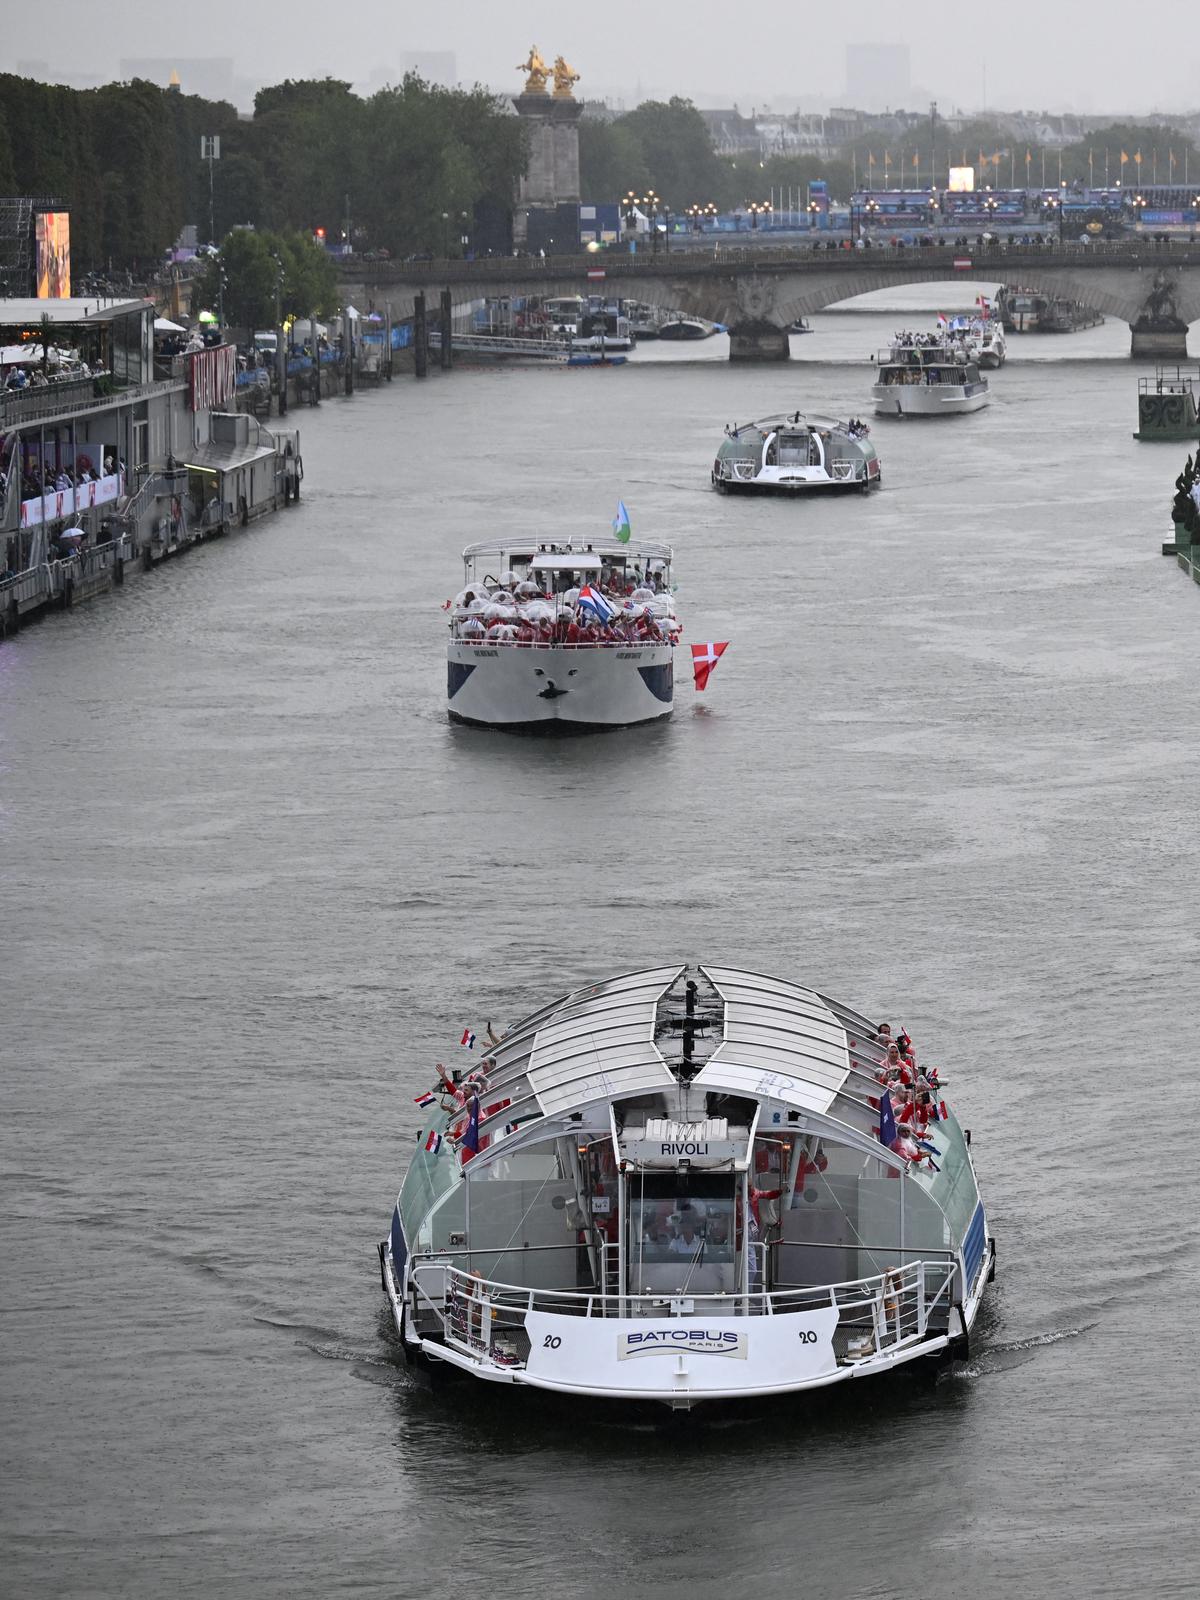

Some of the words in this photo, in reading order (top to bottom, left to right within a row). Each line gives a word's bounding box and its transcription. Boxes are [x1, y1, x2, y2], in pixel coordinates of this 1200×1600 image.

[661, 1143, 708, 1155] RIVOLI
[542, 1334, 561, 1350] 20
[627, 1330, 738, 1344] BATOBUS
[799, 1330, 818, 1344] 20
